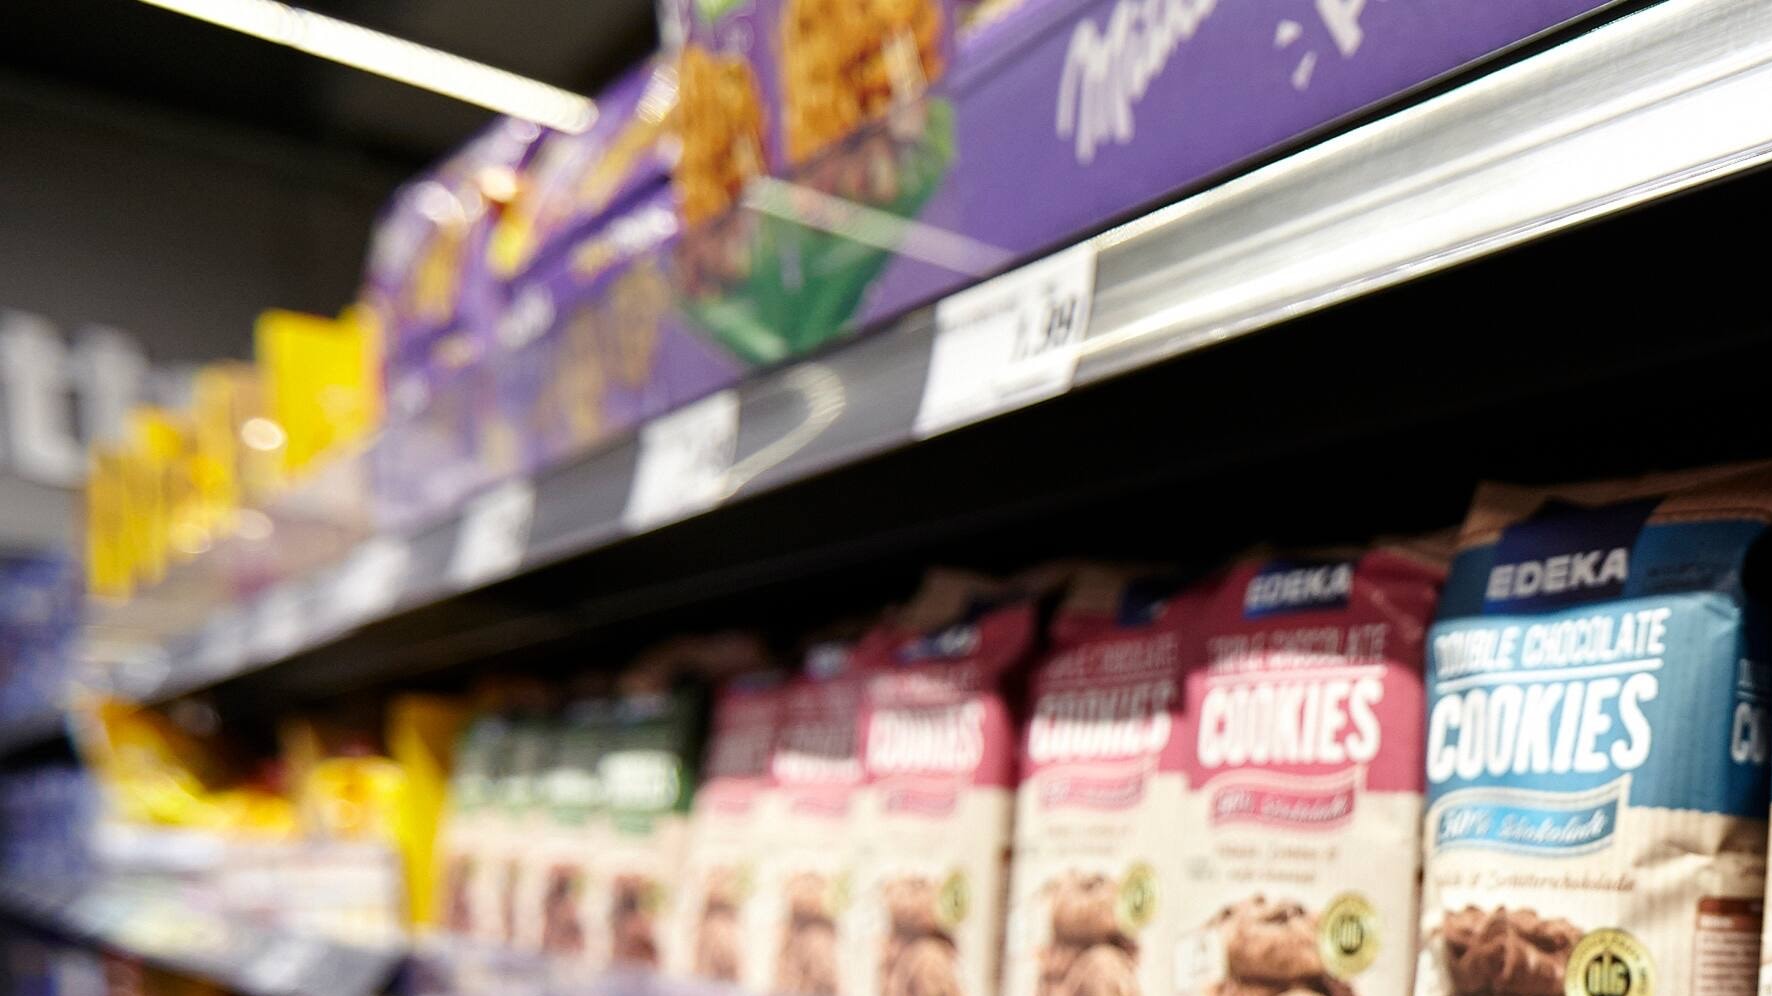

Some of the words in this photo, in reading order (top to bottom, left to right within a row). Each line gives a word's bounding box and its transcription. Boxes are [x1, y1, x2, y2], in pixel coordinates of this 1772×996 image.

[1485, 546, 1629, 601] EDEKA
[1433, 623, 1521, 681] DOUBLE
[1521, 606, 1672, 670] CHOCOLATE
[1199, 680, 1385, 768] COOKIES
[1426, 671, 1660, 784] COOKIES
